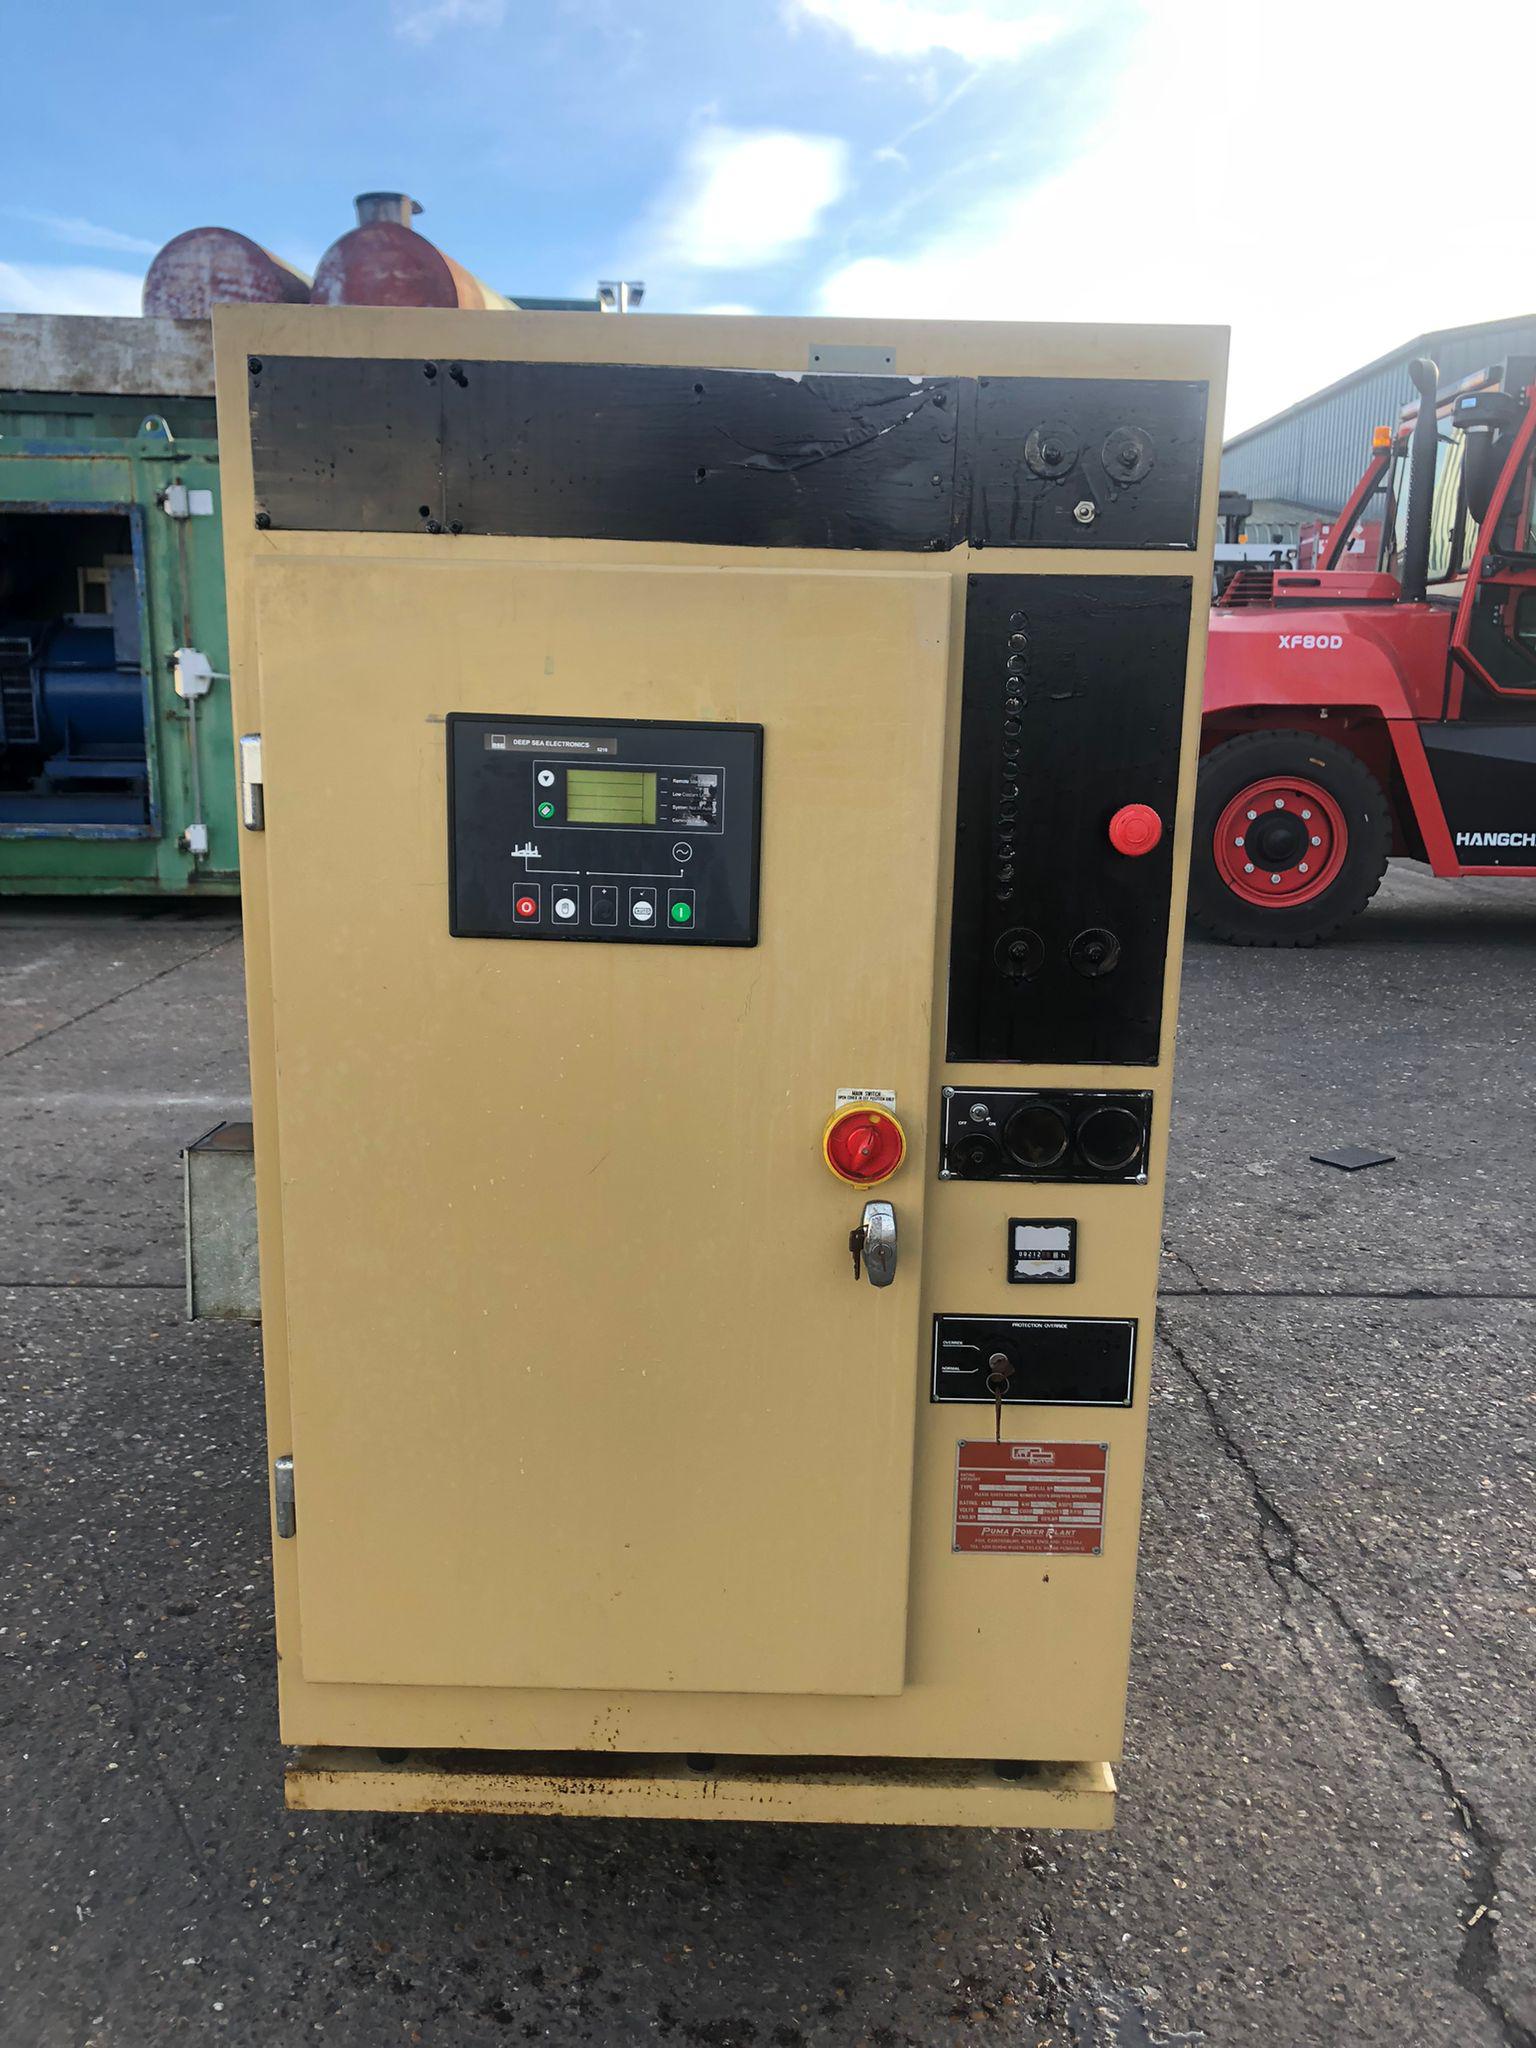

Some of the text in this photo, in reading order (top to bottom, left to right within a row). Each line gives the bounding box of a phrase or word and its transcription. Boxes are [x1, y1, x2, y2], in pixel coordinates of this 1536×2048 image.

[1279, 635, 1343, 649] XF80D
[545, 740, 590, 748] ELECTRONICS
[1456, 832, 1536, 847] HANGCH
[981, 1527, 1077, 1538] PUMA POWER PLANT
